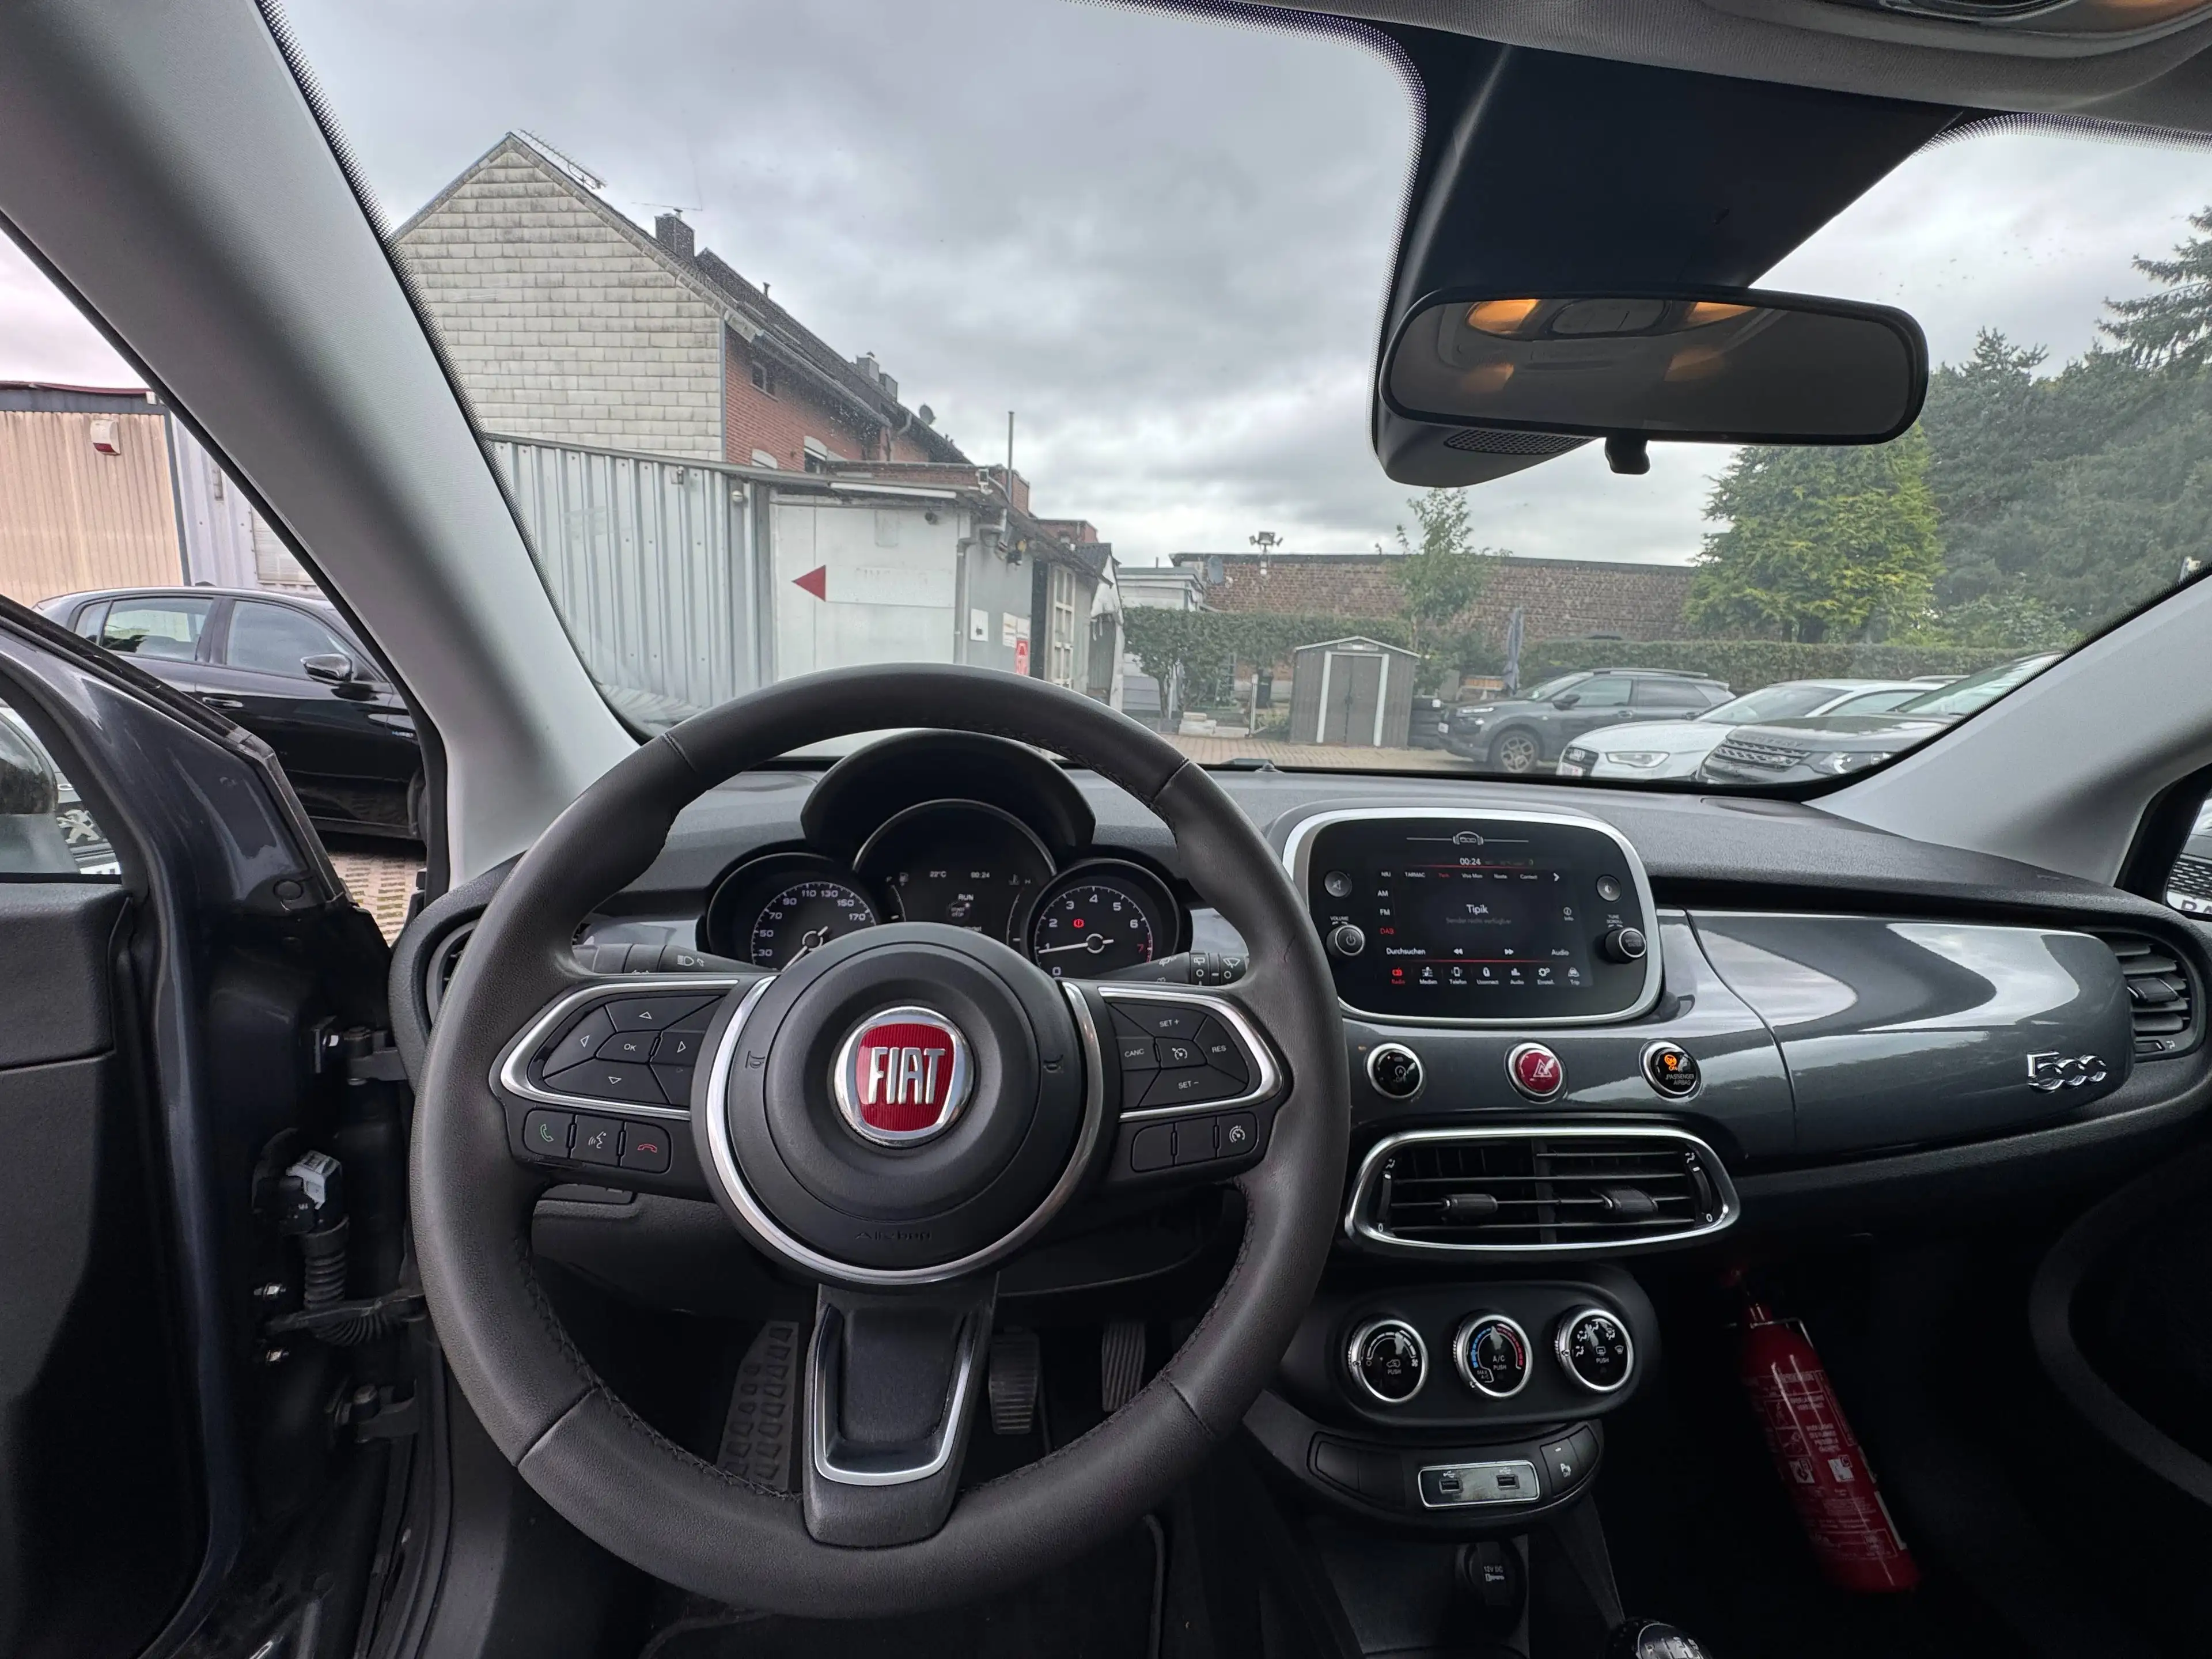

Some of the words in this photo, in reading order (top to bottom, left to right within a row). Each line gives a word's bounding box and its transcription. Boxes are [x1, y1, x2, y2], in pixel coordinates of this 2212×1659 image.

[1460, 857, 1482, 866] 00:24
[970, 871, 991, 879] 00:24
[802, 889, 817, 897] 110
[820, 889, 839, 898] 130
[783, 897, 798, 906] 90
[836, 898, 855, 907] 150
[1089, 894, 1098, 903] 4
[1066, 900, 1075, 910] 3
[1112, 902, 1122, 911] 5
[1466, 903, 1489, 915] Tipik
[768, 911, 783, 920] 70
[849, 912, 867, 921] 170
[1380, 908, 1391, 916] FM
[1048, 918, 1058, 928] 2
[1130, 919, 1139, 929] 6
[759, 929, 774, 938] 50
[1380, 927, 1395, 935] DAB
[758, 949, 773, 957] 30
[1137, 944, 1144, 953] 7
[1386, 946, 1426, 956] Durchsuchen
[1551, 948, 1570, 956] Audio
[1052, 967, 1062, 976] 0
[1159, 1020, 1173, 1028] SET
[623, 1043, 637, 1052] OK
[1211, 1046, 1226, 1054] RES
[1124, 1048, 1145, 1058] CANC
[868, 1047, 946, 1105] FIAT
[1178, 1080, 1192, 1089] SET
[1493, 1354, 1506, 1363] A/C
